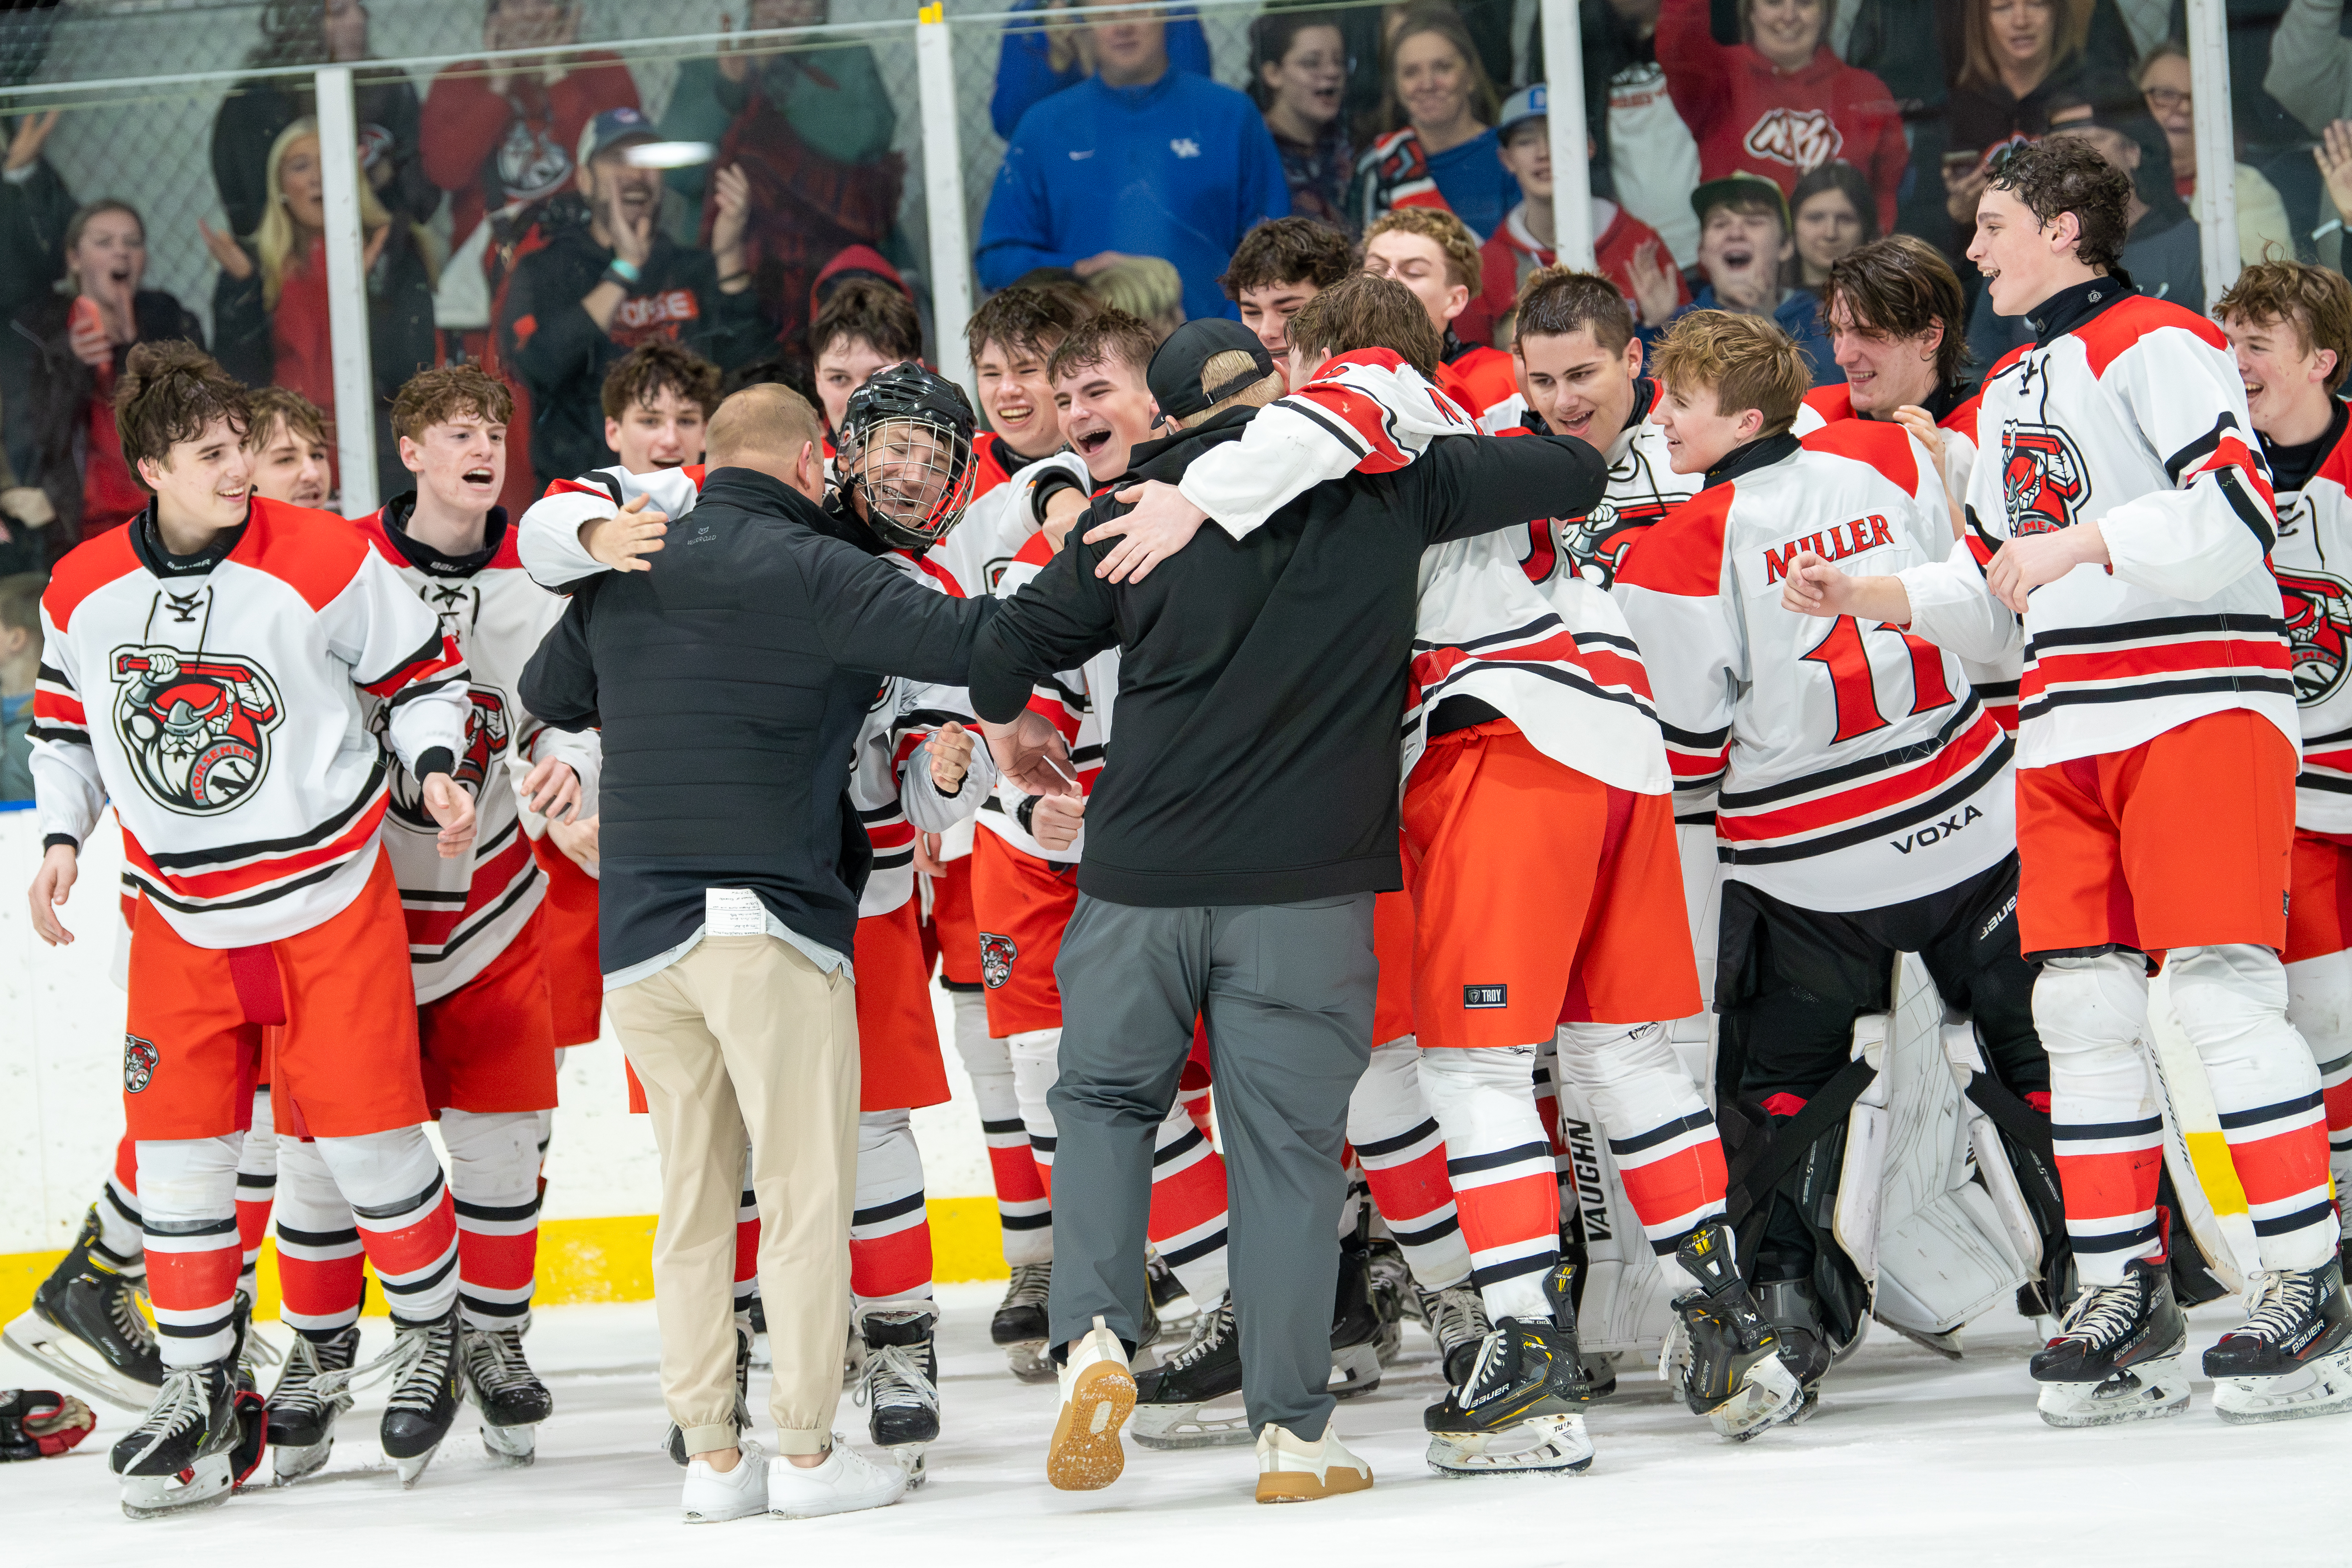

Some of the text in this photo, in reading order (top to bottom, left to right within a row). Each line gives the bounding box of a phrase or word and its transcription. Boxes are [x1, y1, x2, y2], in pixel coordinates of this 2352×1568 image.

[192, 745, 254, 800] NORSEMEN
[1890, 804, 1984, 854] VOXA
[1979, 892, 2018, 940] BAUE
[1481, 989, 1502, 1002] TROY
[1566, 1118, 1612, 1242] VAUGHN
[2292, 1319, 2325, 1354] BAUER
[1470, 1383, 1509, 1408] BAUER
